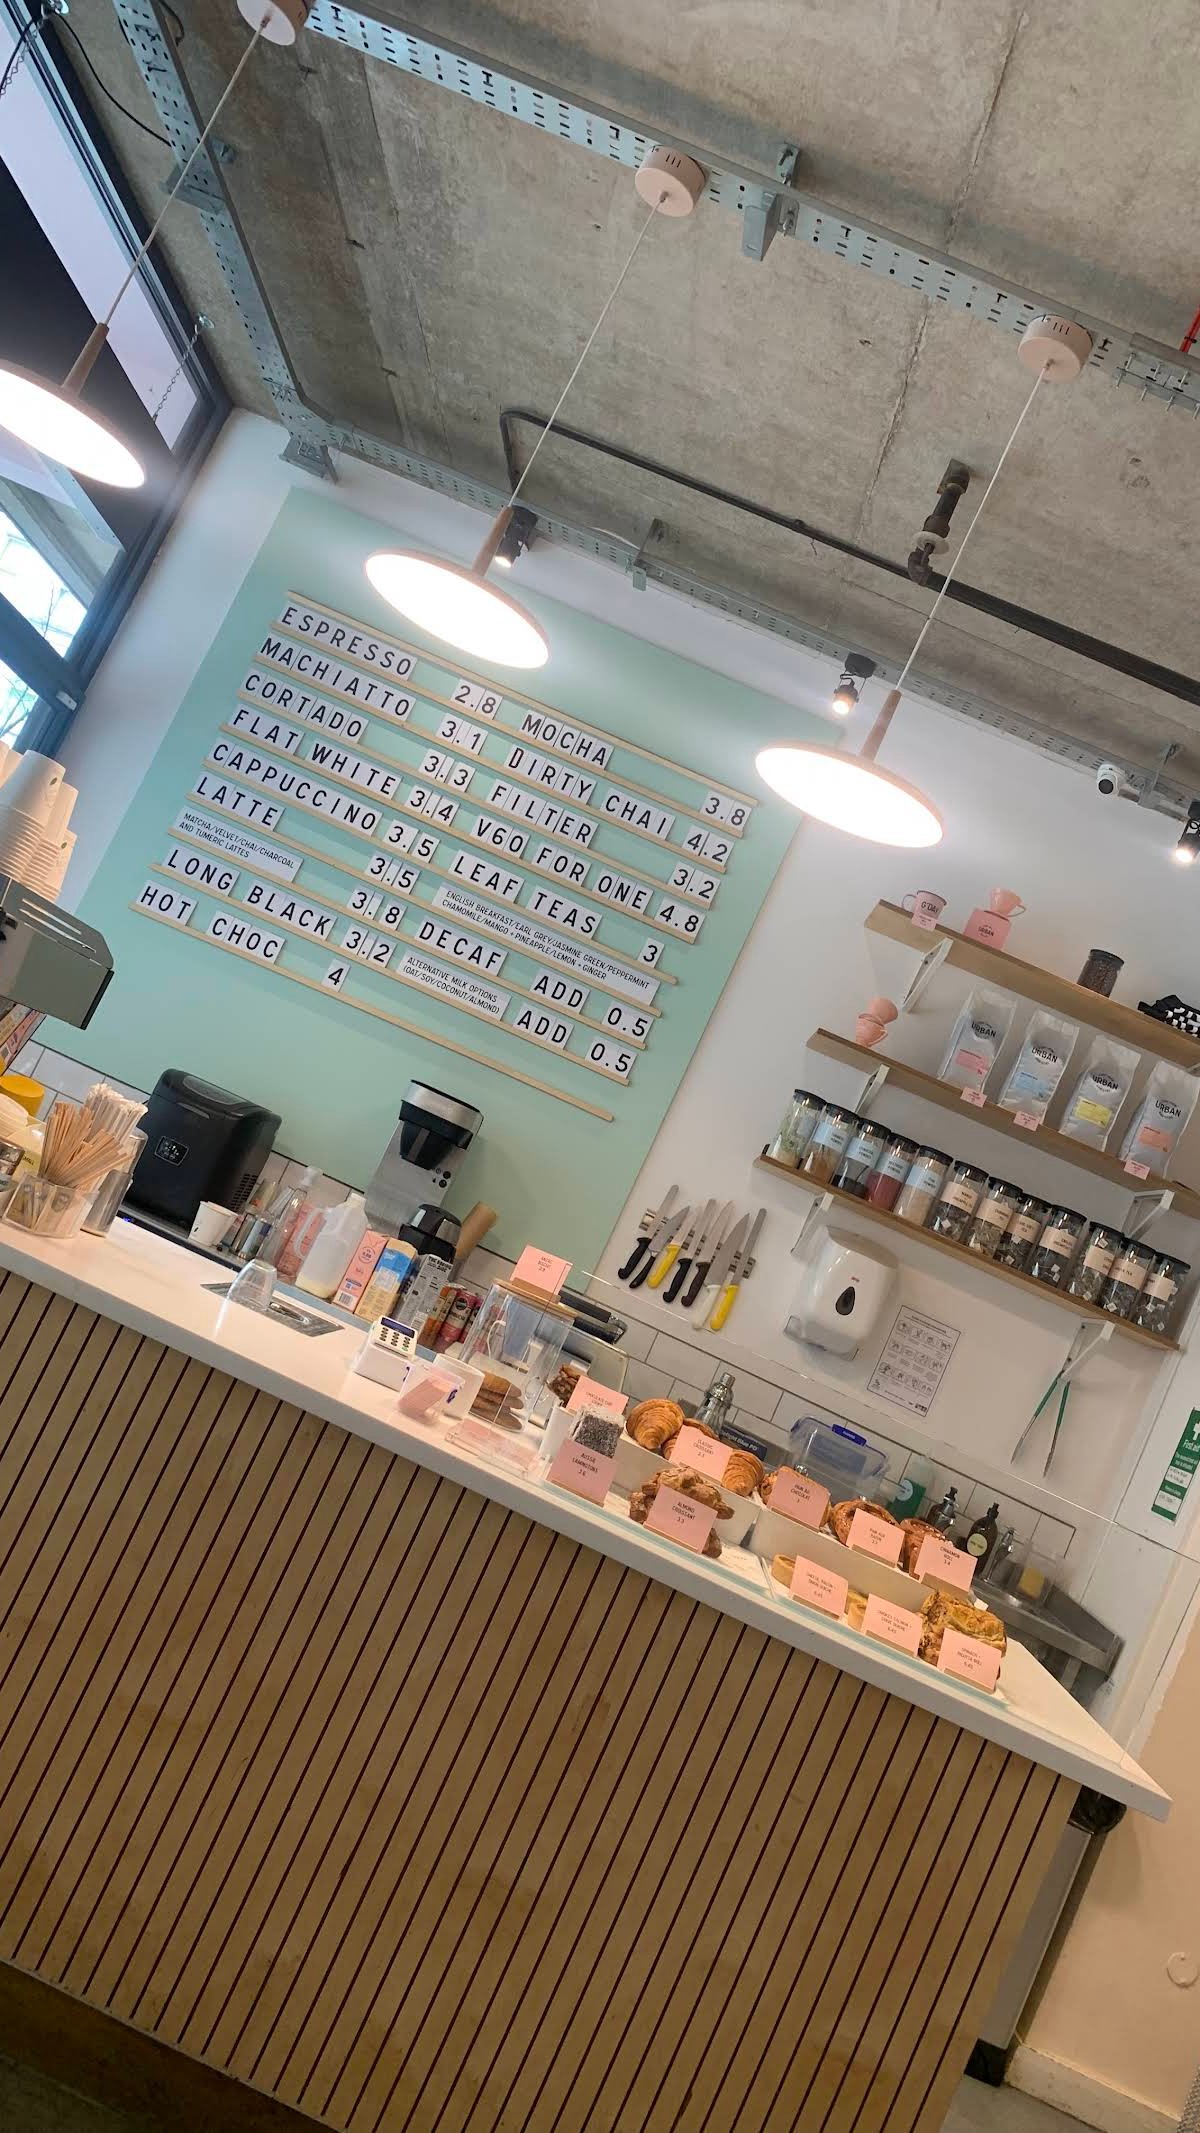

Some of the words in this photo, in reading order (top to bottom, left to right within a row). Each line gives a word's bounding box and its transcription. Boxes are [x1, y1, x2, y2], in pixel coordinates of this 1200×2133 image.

[261, 638, 410, 716] MACHIATTO
[442, 721, 481, 750] 3.1
[282, 607, 412, 676] ESPRESSO
[455, 686, 495, 713] 2.8
[233, 709, 300, 751] FLAT
[312, 744, 395, 795] WHITE
[411, 791, 453, 821] 3.4
[245, 675, 362, 738] CORTADO
[425, 756, 468, 786] 3.3
[522, 715, 606, 766] MOCHA
[706, 798, 745, 825] 3.8
[179, 821, 194, 833] AND
[195, 828, 224, 847] TUMERIC
[225, 842, 250, 858] LATTES
[183, 812, 295, 869] MATCHA/VELVET/CHAI/CHARCOAL
[196, 777, 279, 827] LATTE
[371, 858, 414, 890] 3.5
[213, 744, 376, 830] CAPPUCCINO
[389, 826, 434, 856] 3.5
[491, 785, 592, 843] FILTER
[674, 869, 715, 899] 3.2
[509, 748, 591, 797] DIRTY
[606, 795, 668, 834] CHAI
[688, 834, 727, 862] 4.2
[168, 850, 234, 890] LONG
[248, 886, 332, 936] BLACK
[347, 931, 390, 963] 3.2
[353, 892, 401, 925] 3.8
[454, 856, 519, 901] LEAF
[534, 892, 597, 935] TEAS
[643, 945, 658, 962] 3
[478, 819, 523, 853] V60
[537, 847, 586, 882] FOR
[598, 876, 648, 910] ONE
[660, 906, 699, 934] 4.8
[141, 886, 192, 920] HOT
[213, 918, 279, 958] CHOC
[328, 967, 344, 986] 4
[407, 956, 450, 981] ALTERNATIVE
[451, 976, 468, 989] MILK
[468, 985, 498, 1003] OPTIONS
[419, 922, 502, 971] DECAF
[534, 976, 584, 1009] ADD
[608, 1008, 649, 1038] 0.5
[442, 899, 509, 935] CHAMOMILE/MANGO
[514, 932, 577, 966] PINEAPPLE/LEMON
[582, 964, 607, 980] GINGER
[446, 890, 475, 909] ENGLISH
[475, 904, 532, 935] BREAKFAST/EARL
[533, 931, 583, 958] GREY/JASMINE
[583, 954, 650, 989] GREEN/PEPPERMINT
[403, 965, 500, 1015] (OAT/SOY/COCONUT/ALMOND)
[971, 1021, 997, 1039] URBAN
[517, 1011, 568, 1047] ADD
[591, 1043, 630, 1074] 0.5
[1031, 1046, 1059, 1064] URBAN
[1092, 1074, 1119, 1091] URBAN
[1154, 1099, 1181, 1118] URBAN
